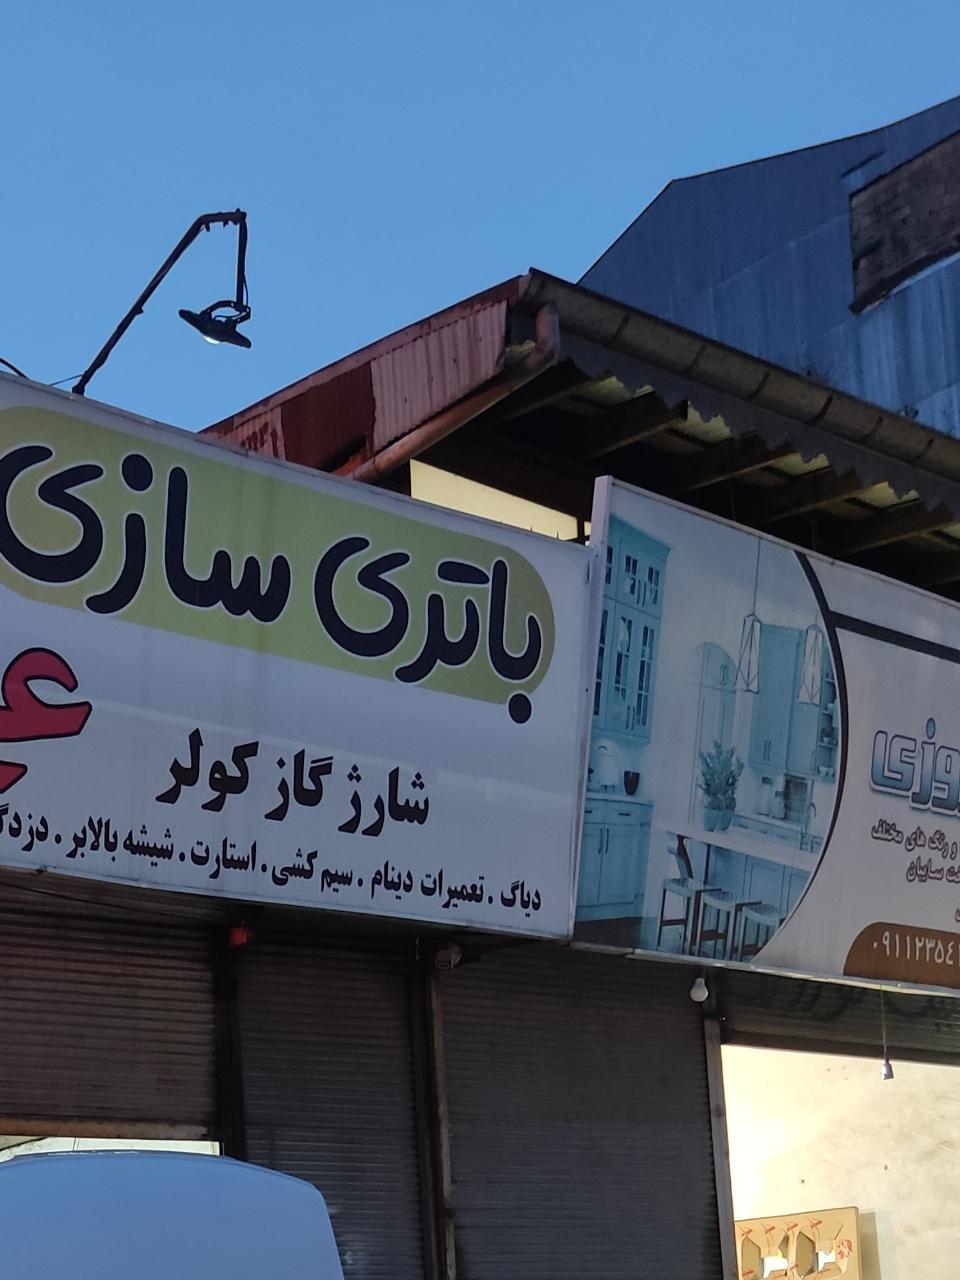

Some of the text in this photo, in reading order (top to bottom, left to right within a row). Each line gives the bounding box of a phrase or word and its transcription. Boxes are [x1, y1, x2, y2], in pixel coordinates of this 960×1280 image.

[314, 536, 543, 724] باتری
[155, 728, 430, 837] شارژ گاز کولر
[66, 815, 119, 863] بالابر
[122, 824, 175, 867] شیشه
[190, 836, 258, 879] استارت
[271, 848, 318, 886] کشی
[320, 866, 353, 893] سیم
[371, 859, 414, 899] دینام
[420, 867, 485, 908] تعمیرات
[500, 880, 541, 917] دیاگ
